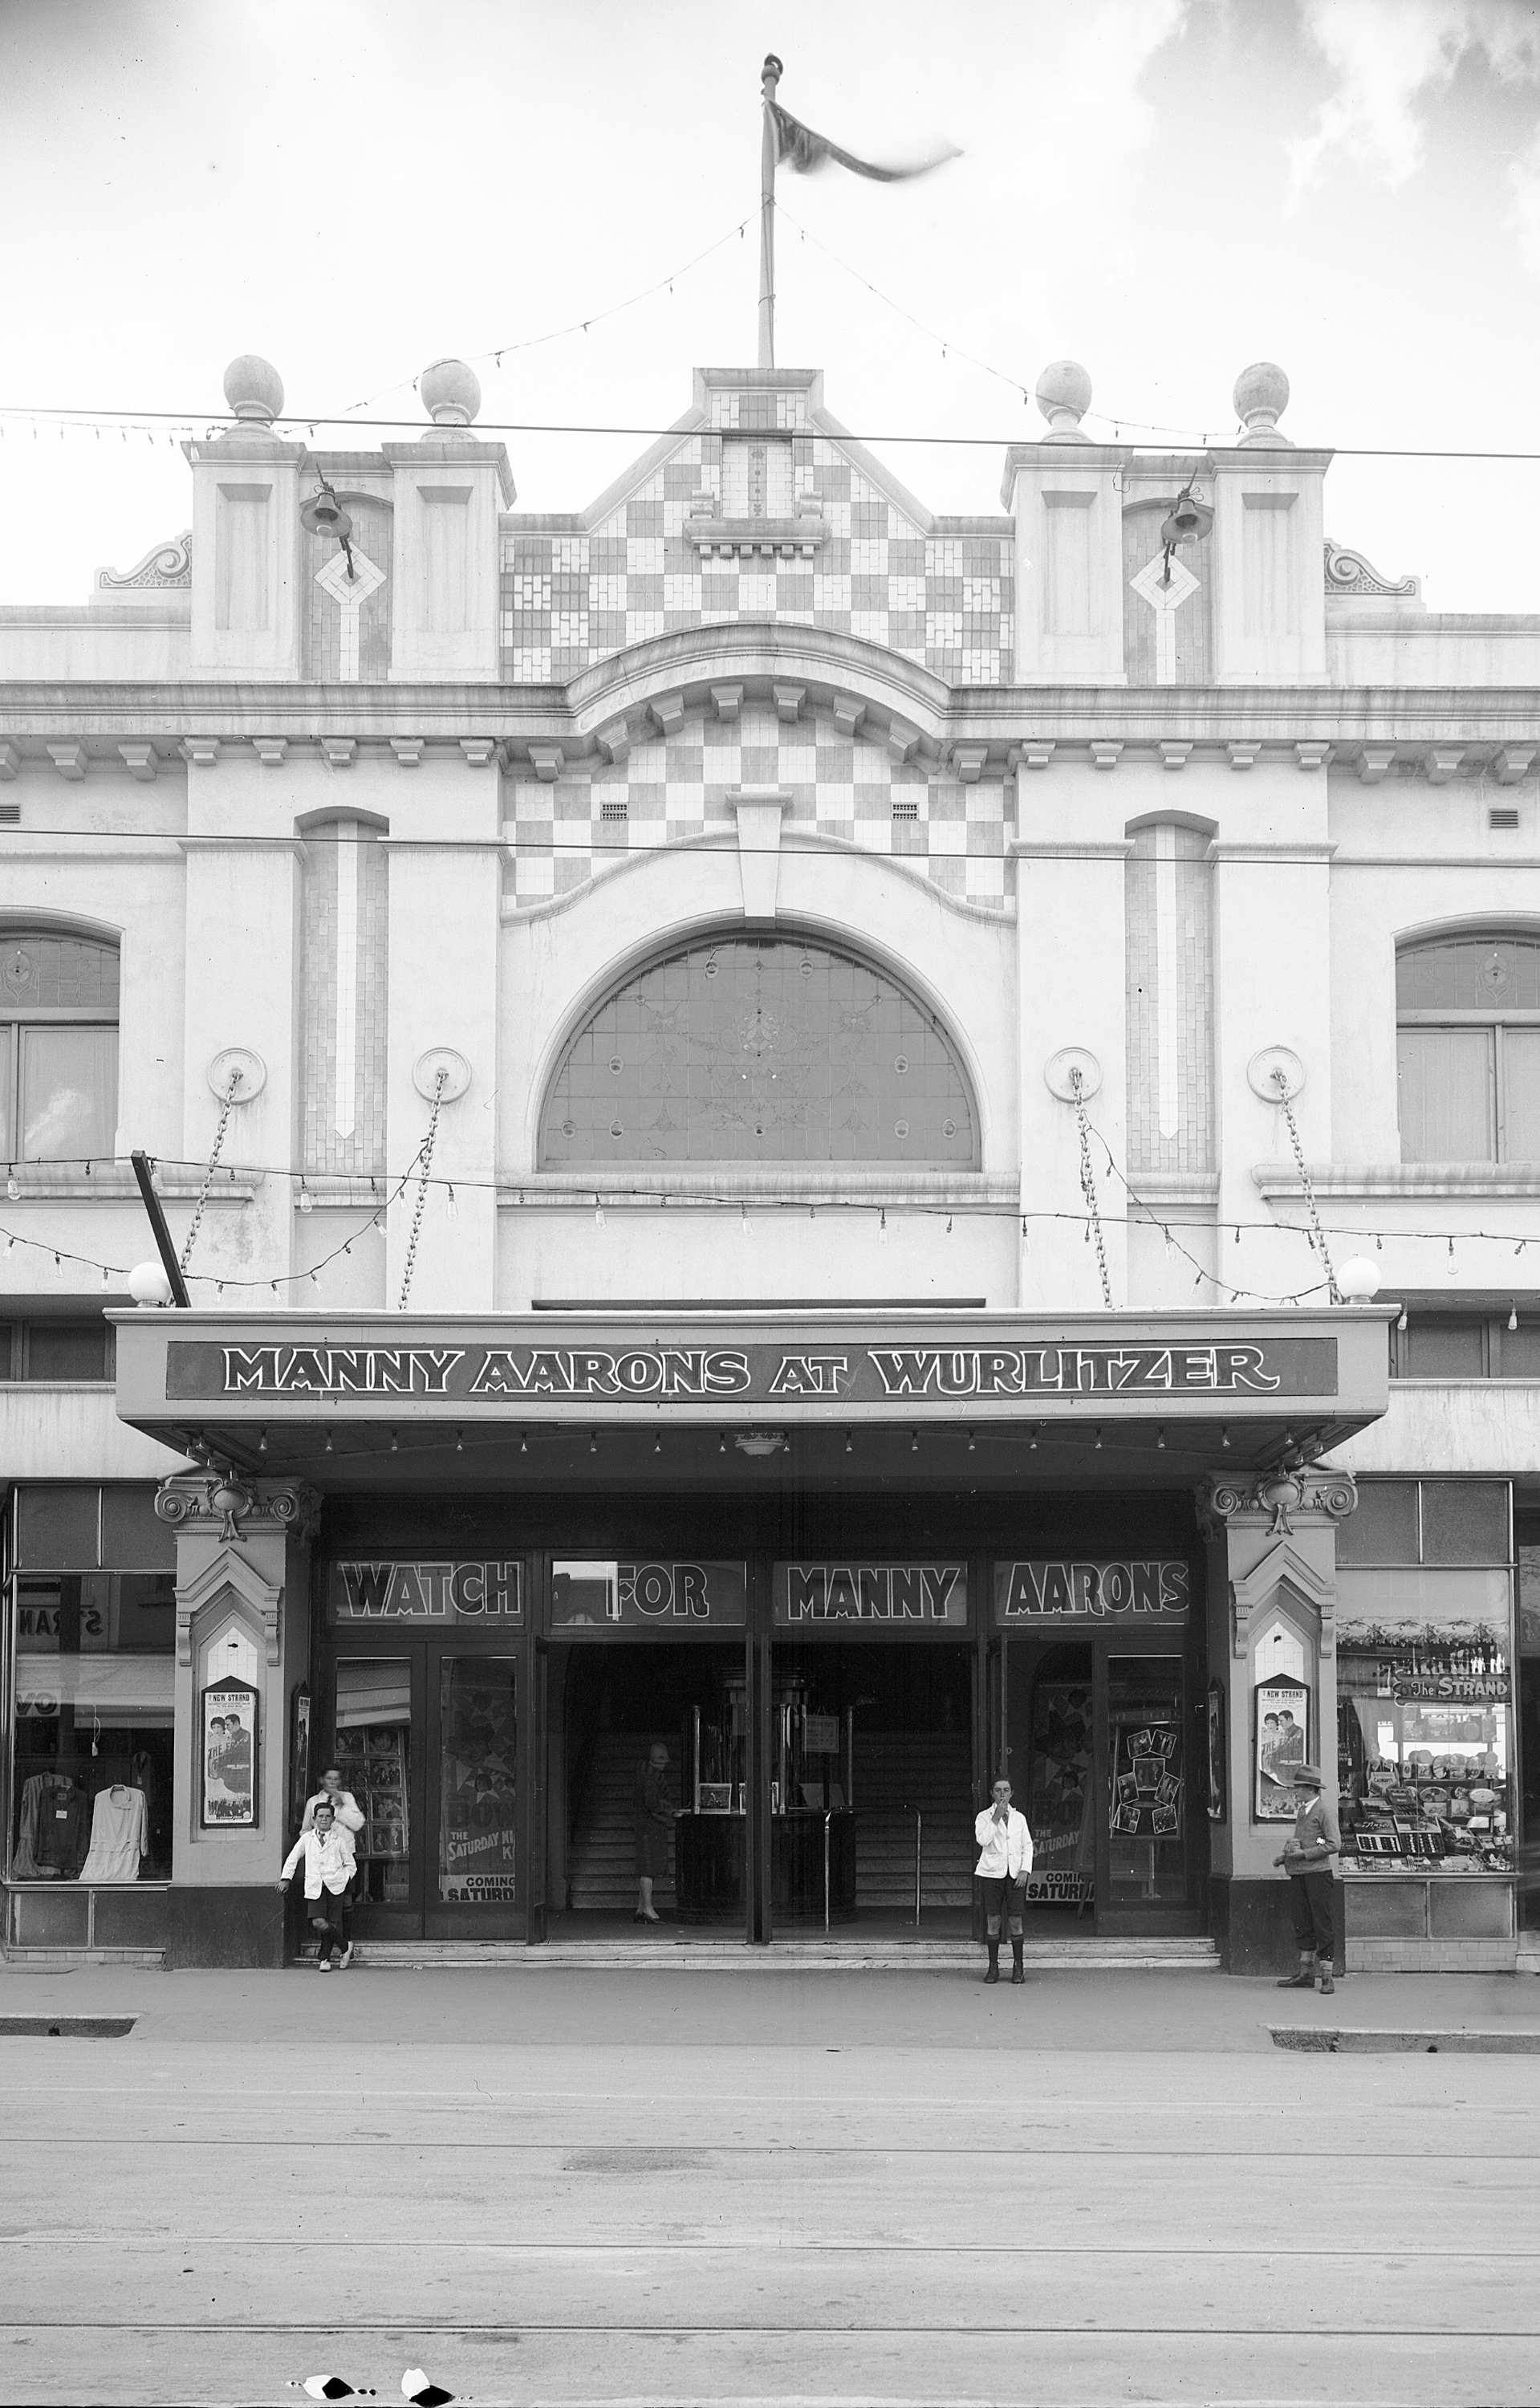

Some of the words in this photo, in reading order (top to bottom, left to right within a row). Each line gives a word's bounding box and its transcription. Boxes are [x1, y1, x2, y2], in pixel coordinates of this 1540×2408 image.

[221, 1348, 465, 1391] MANNY
[469, 1350, 750, 1394] AARONS
[769, 1356, 847, 1393] AT
[868, 1346, 1281, 1394] WURLITZER
[341, 1562, 521, 1617] WATCH
[606, 1564, 710, 1617] FOR
[787, 1567, 961, 1619] MANNY
[1005, 1563, 1189, 1616] AARONS
[1411, 1681, 1434, 1696] The
[1438, 1677, 1509, 1695] STRAND
[449, 1832, 499, 1861] SATURDAY
[450, 1831, 469, 1840] THE
[1033, 1831, 1080, 1857] SATURDAY
[1034, 1829, 1052, 1837] THE
